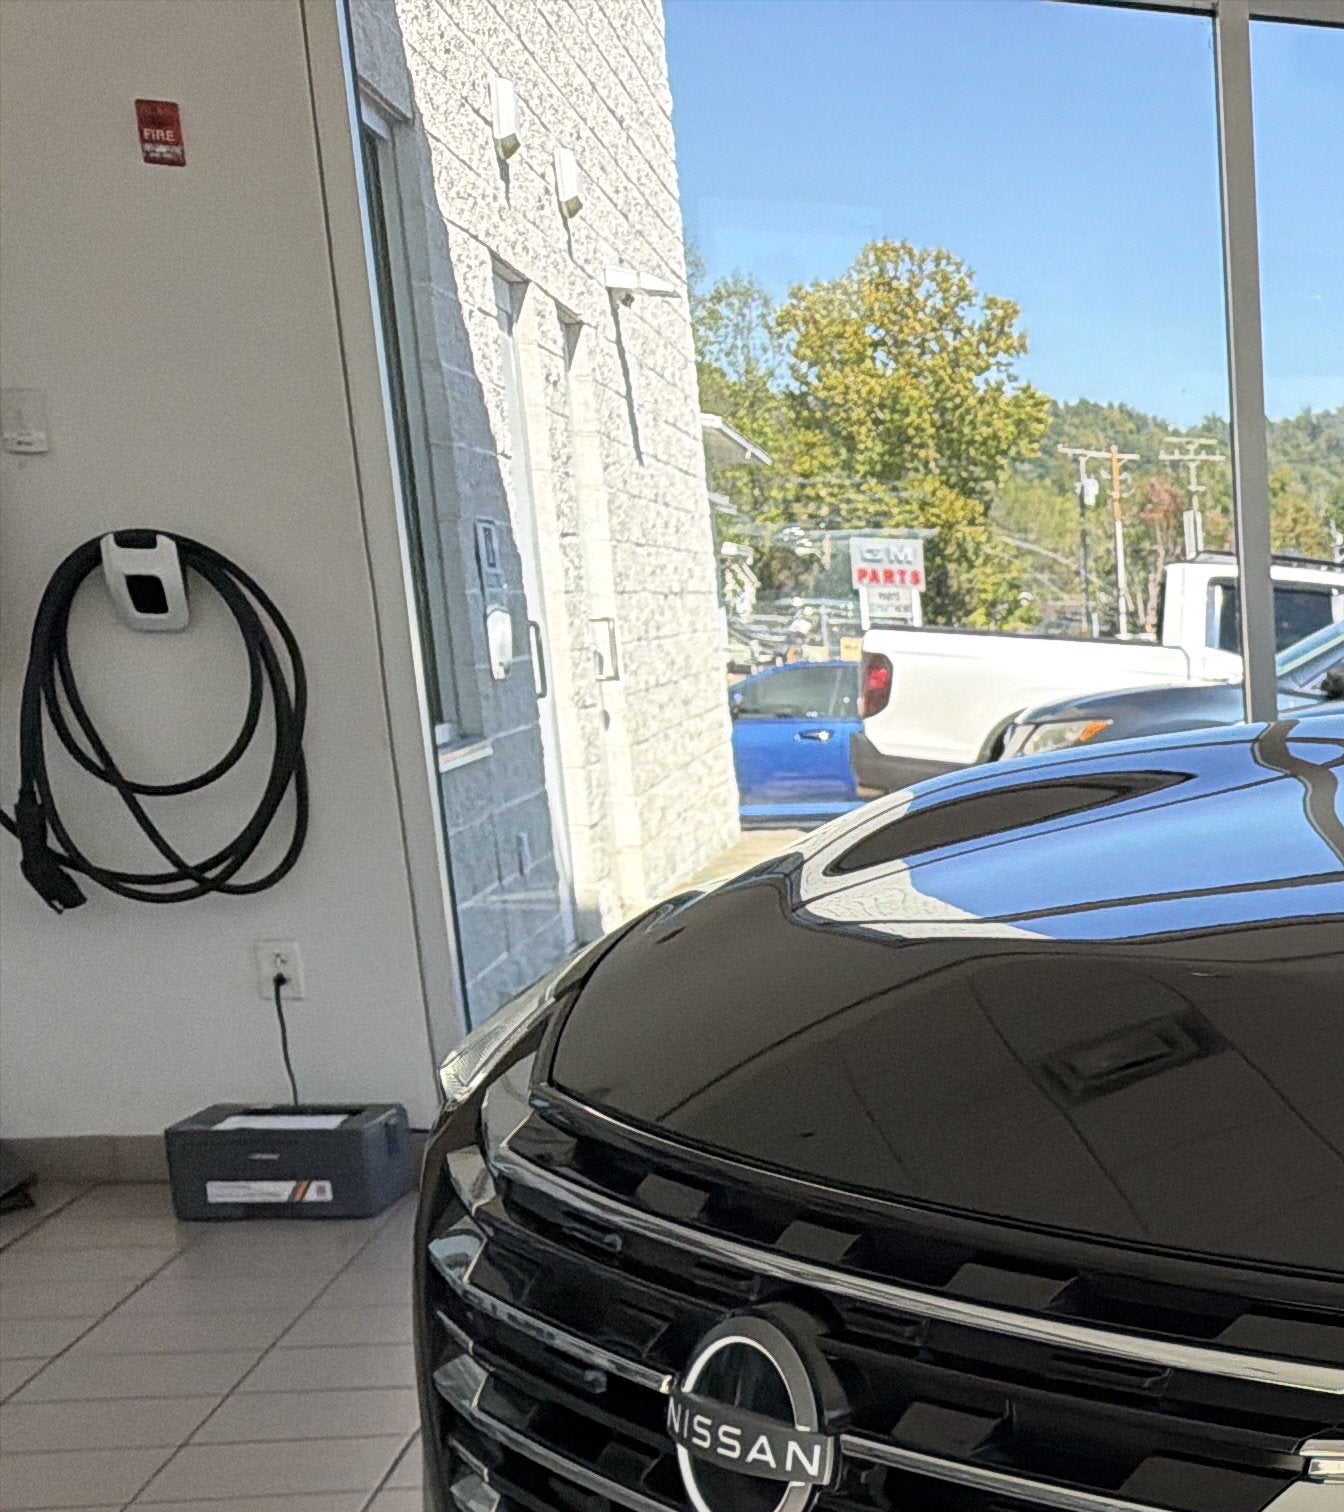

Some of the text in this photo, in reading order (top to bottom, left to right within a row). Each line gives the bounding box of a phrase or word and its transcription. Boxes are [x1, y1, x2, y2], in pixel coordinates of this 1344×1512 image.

[143, 127, 175, 141] FIRE
[857, 567, 921, 586] PARTS
[667, 1397, 821, 1477] NISSAN
